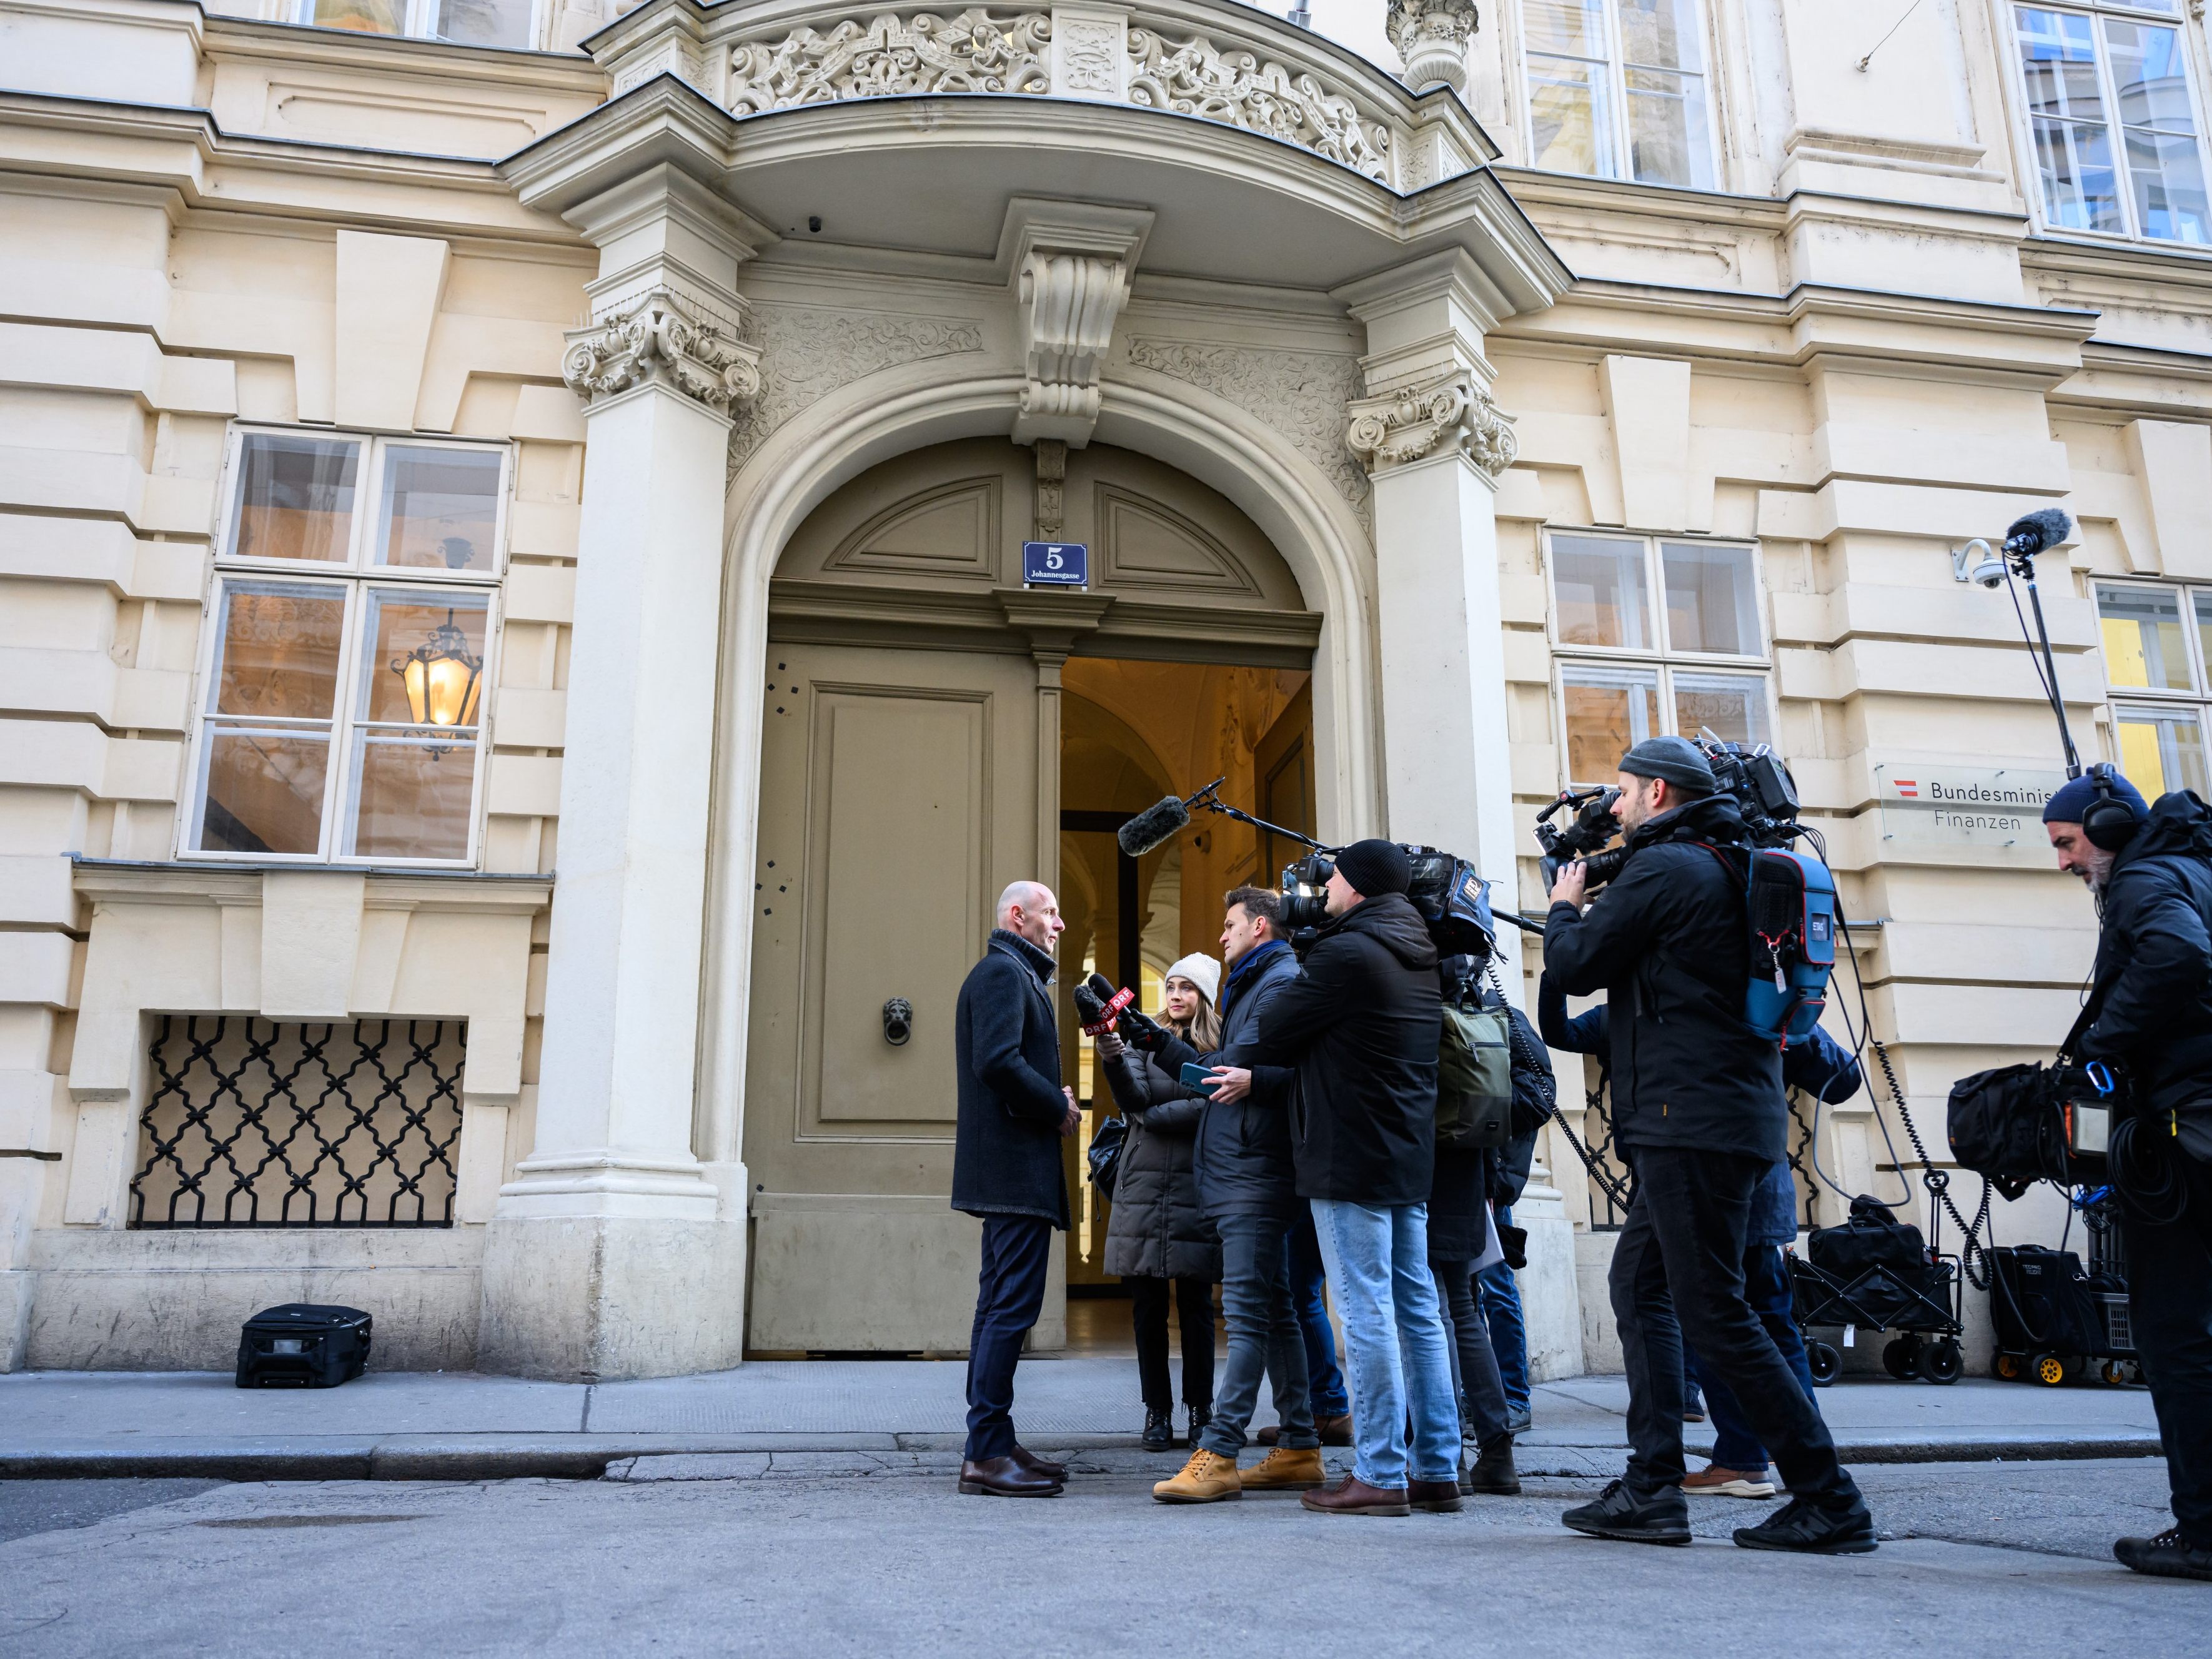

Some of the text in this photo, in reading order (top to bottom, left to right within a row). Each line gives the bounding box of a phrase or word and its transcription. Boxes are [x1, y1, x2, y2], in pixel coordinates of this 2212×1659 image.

[1046, 547, 1063, 570] 5
[1031, 570, 1080, 580] Johannesgasse
[1931, 782, 2058, 804] Bundesminis
[1935, 810, 2021, 830] Finanzen
[1113, 989, 1130, 1007] ORF
[1102, 1004, 1114, 1019] ORF
[1086, 1023, 1107, 1034] ORF
